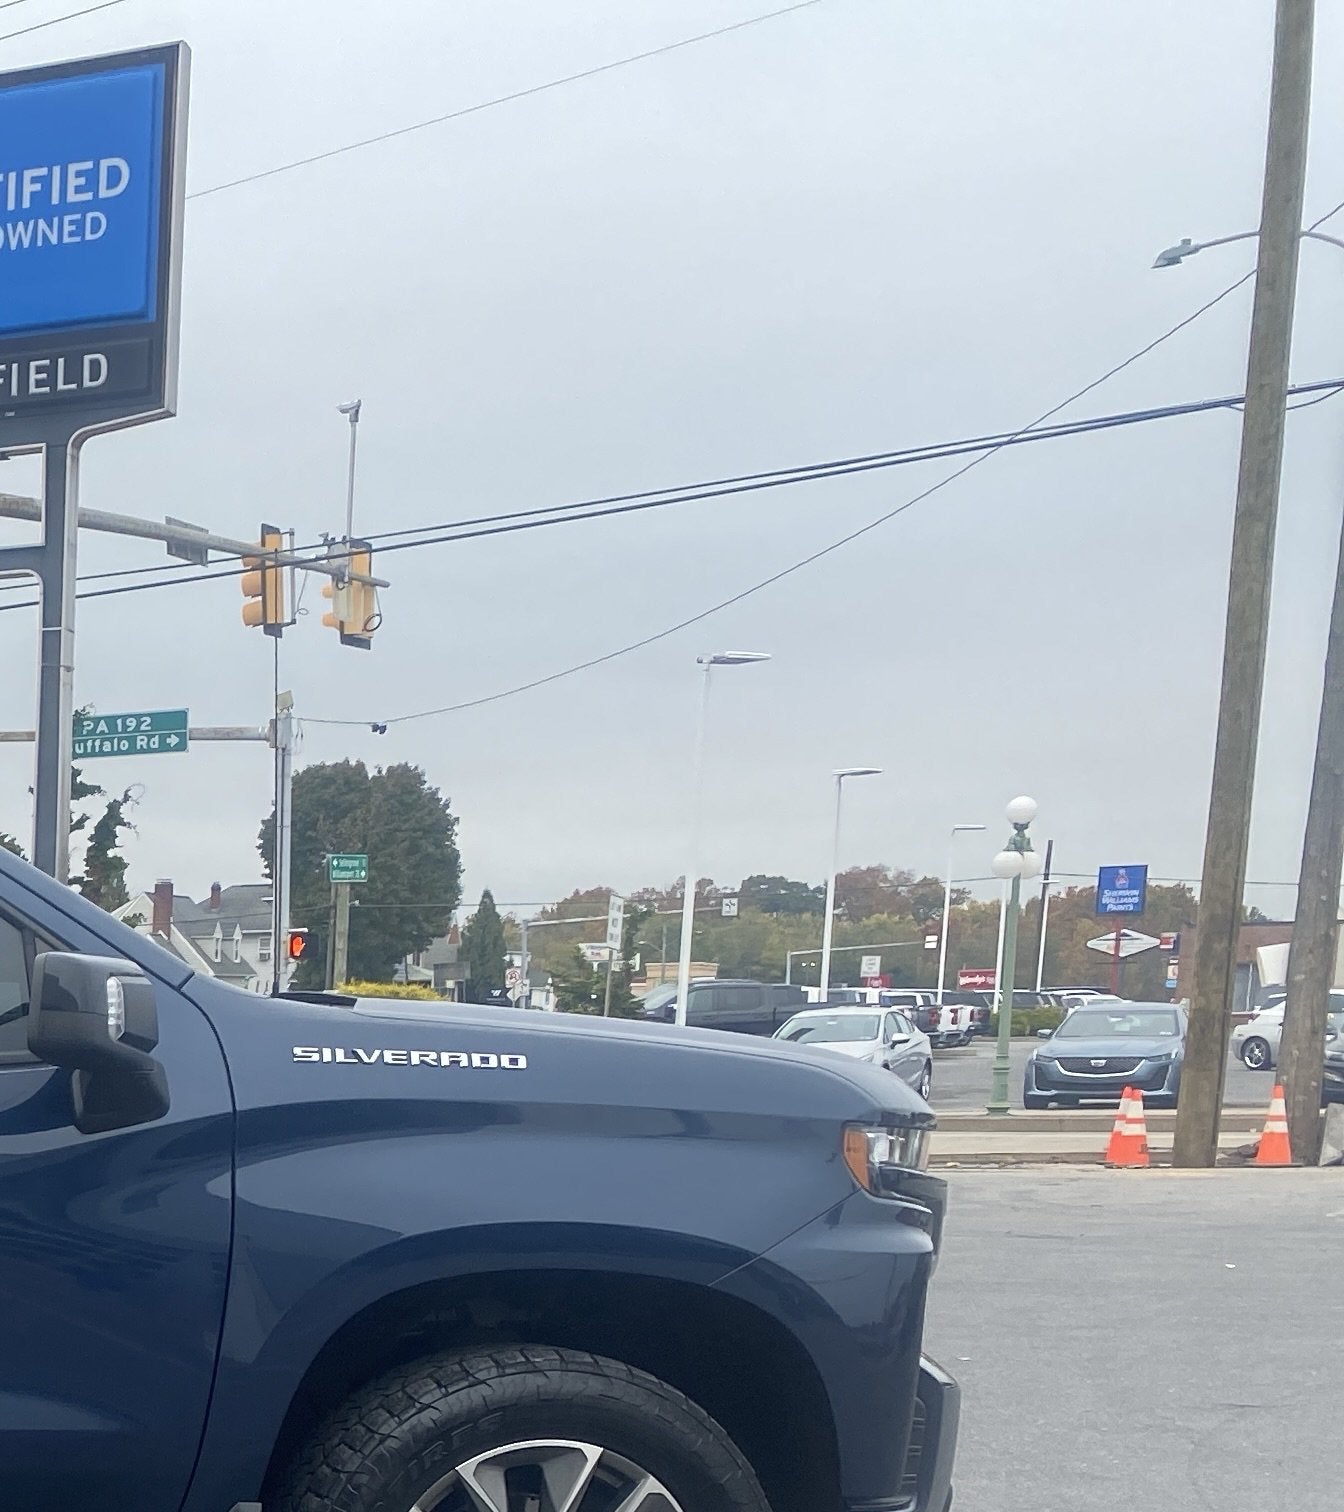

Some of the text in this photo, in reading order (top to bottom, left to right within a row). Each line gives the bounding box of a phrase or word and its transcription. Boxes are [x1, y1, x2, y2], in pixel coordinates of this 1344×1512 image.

[82, 716, 152, 735] PA 192
[74, 734, 160, 755] uffalo Rd
[292, 1046, 528, 1070] SILVERADO
